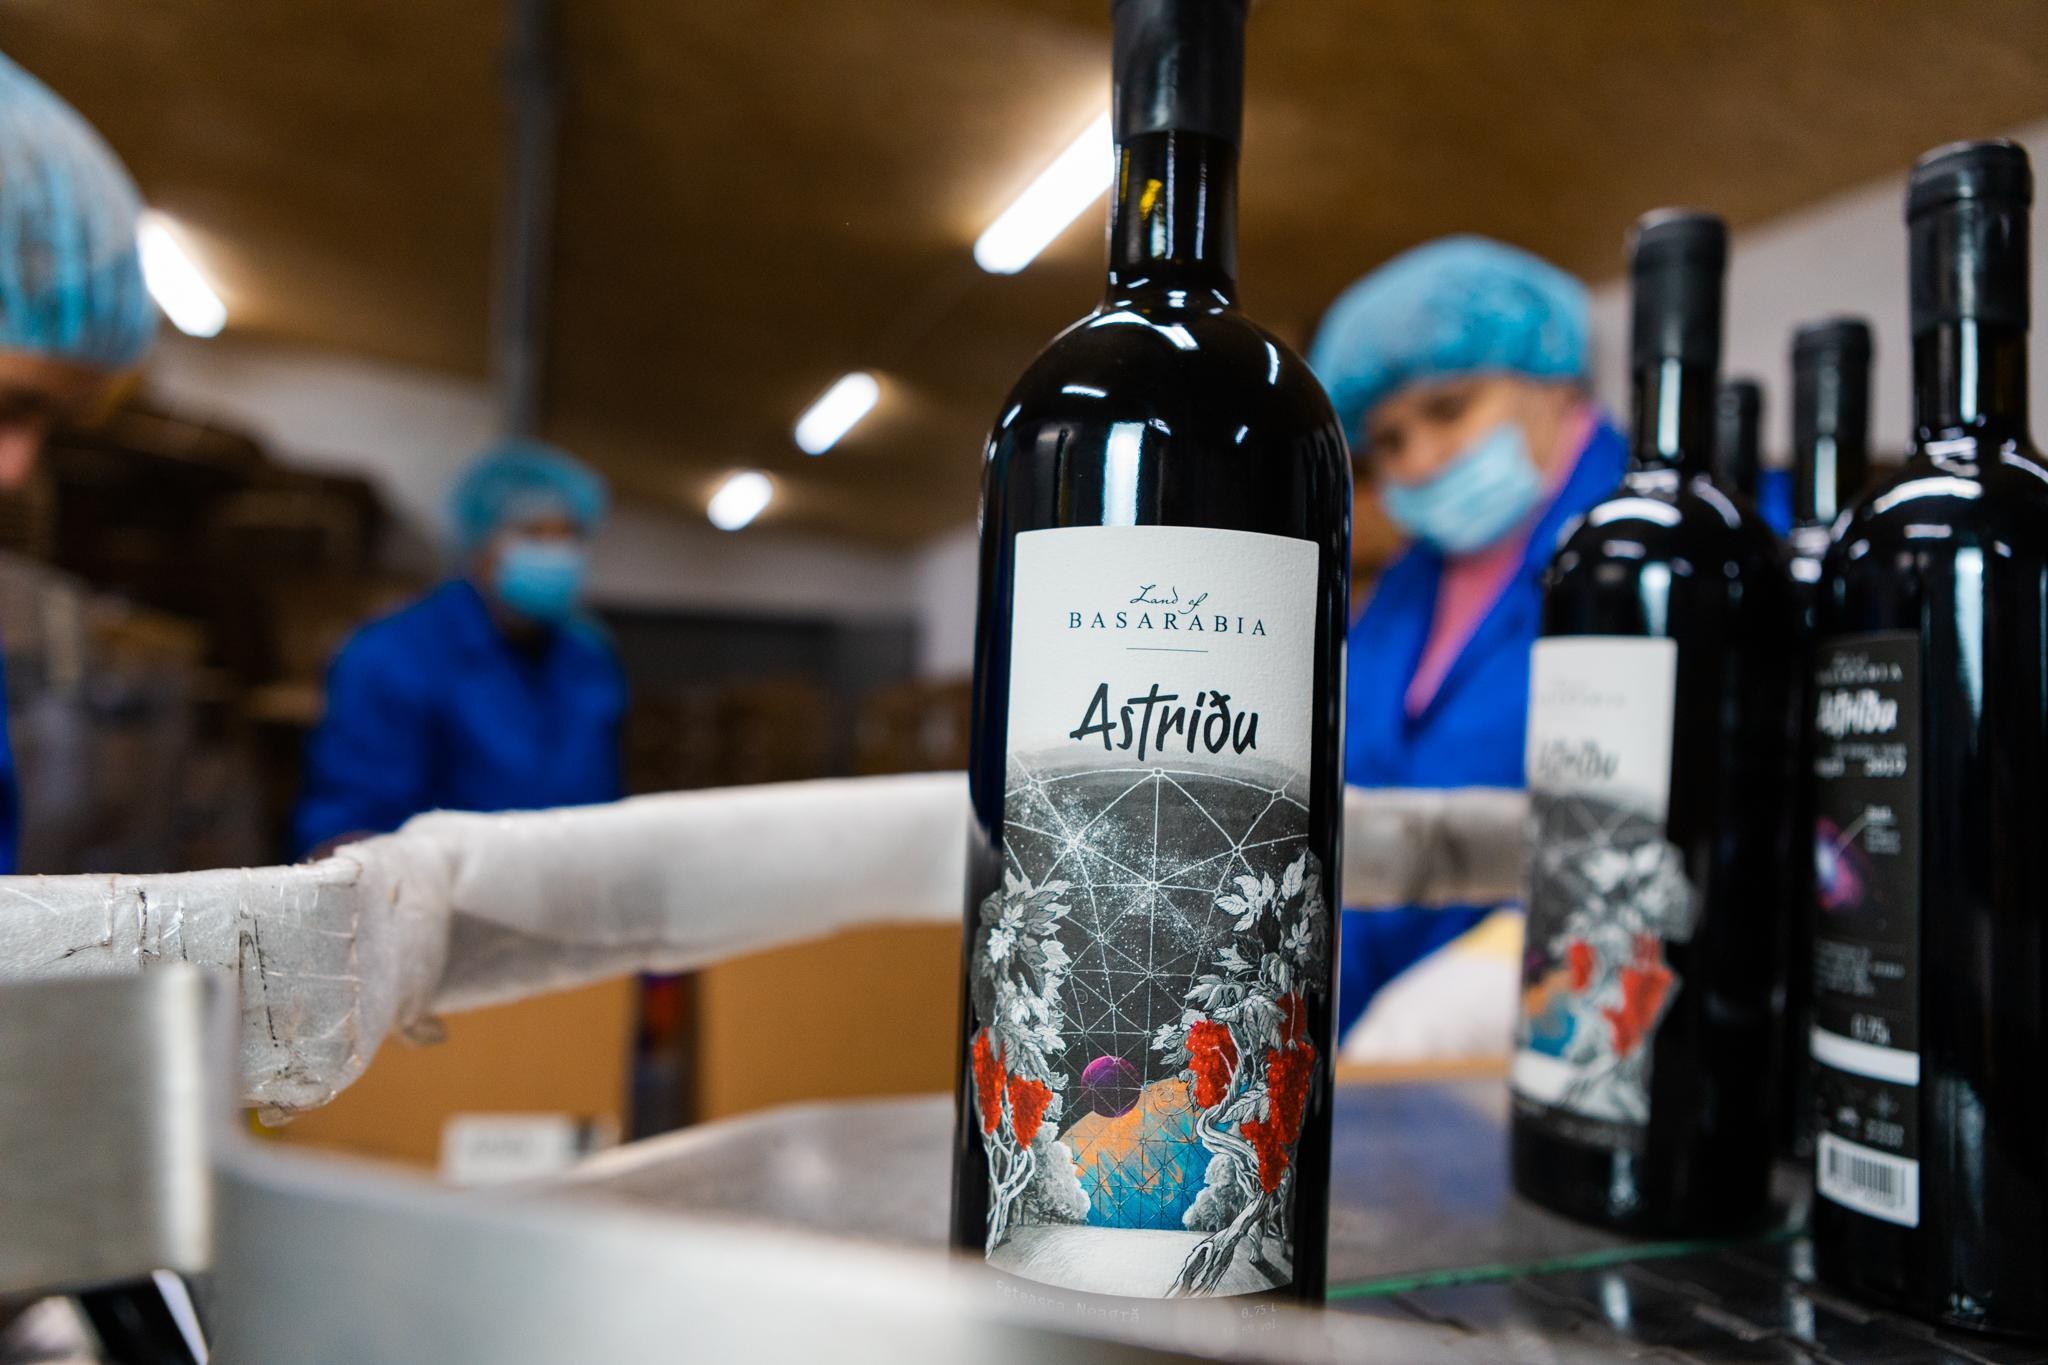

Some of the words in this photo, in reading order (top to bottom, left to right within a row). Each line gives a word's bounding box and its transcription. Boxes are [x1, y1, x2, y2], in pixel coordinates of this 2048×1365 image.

[1130, 584, 1179, 605] Land
[1177, 592, 1209, 615] of
[1068, 611, 1267, 636] BASARABIA
